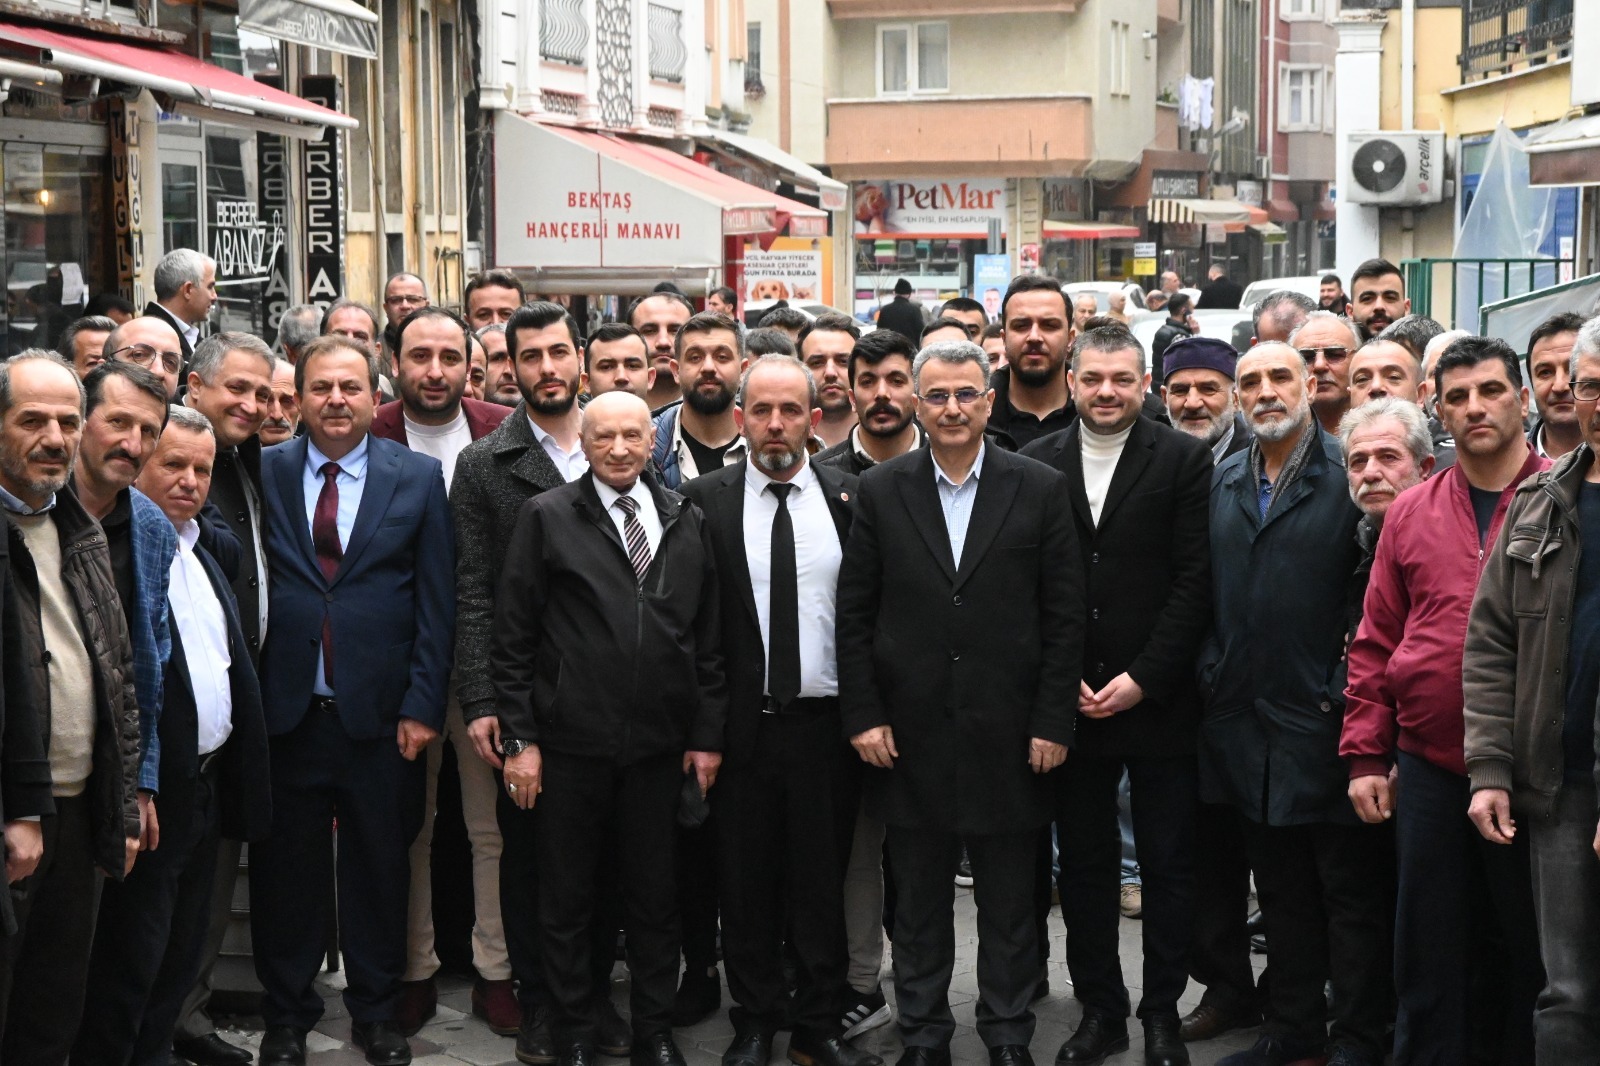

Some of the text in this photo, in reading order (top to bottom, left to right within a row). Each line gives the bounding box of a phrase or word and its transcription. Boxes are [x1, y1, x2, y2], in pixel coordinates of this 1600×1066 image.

[1418, 136, 1432, 181] arçelik
[567, 191, 632, 213] BEKTAŞ
[896, 182, 1002, 210] PetMar
[216, 201, 258, 227] BERBER
[938, 215, 950, 223] EN
[526, 218, 681, 243] HANÇERLİ MANAVI
[213, 227, 267, 276] ABANOZ
